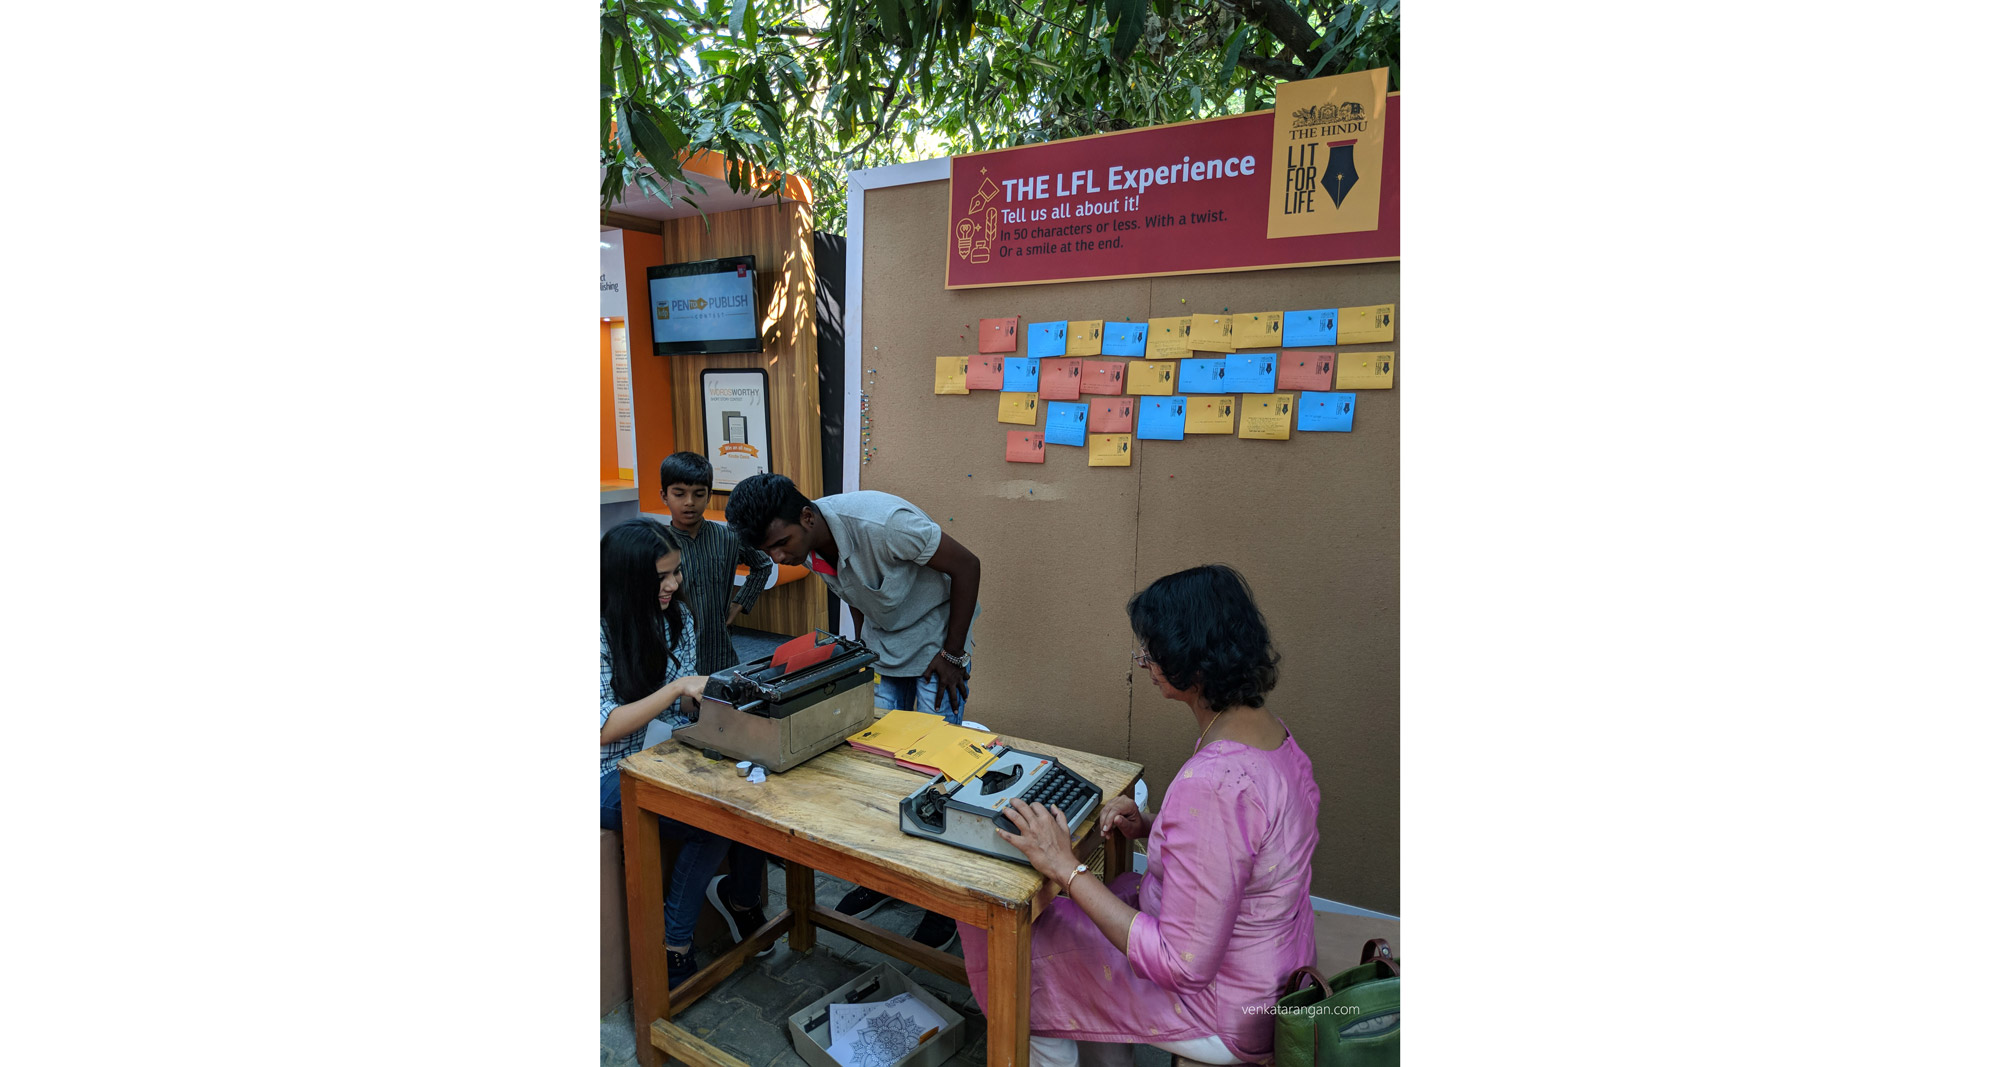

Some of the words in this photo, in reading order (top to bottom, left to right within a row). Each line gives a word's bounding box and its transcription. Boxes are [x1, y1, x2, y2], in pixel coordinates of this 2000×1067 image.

[1289, 128, 1317, 140] THE
[1321, 121, 1368, 136] HINDU
[1288, 143, 1319, 168] LIT
[1002, 175, 1050, 202] THE
[1057, 169, 1100, 197] LFL
[1108, 155, 1255, 194] Experience
[1286, 167, 1316, 192] FOR
[1001, 208, 1026, 224] Tell
[1031, 208, 1047, 221] us
[1051, 203, 1071, 219] all
[1076, 198, 1119, 216] about
[1124, 195, 1139, 212] it!
[1285, 190, 1315, 214] LIFE
[1000, 230, 1010, 241] In
[1014, 228, 1028, 240] 50
[1031, 224, 1092, 239] characters
[1096, 222, 1109, 232] or
[1113, 220, 1140, 231] less.
[1145, 214, 1174, 228] With
[1178, 215, 1186, 225] a
[1191, 210, 1227, 224] twist.
[1000, 246, 1013, 257] Or
[1016, 248, 1022, 256] a
[1026, 242, 1057, 256] smile
[1060, 242, 1072, 253] at
[1075, 240, 1094, 251] the
[1098, 236, 1123, 249] end.
[672, 299, 690, 312] PEN
[709, 295, 748, 309] PUBLISH
[710, 388, 759, 396] WORDSWORTHY
